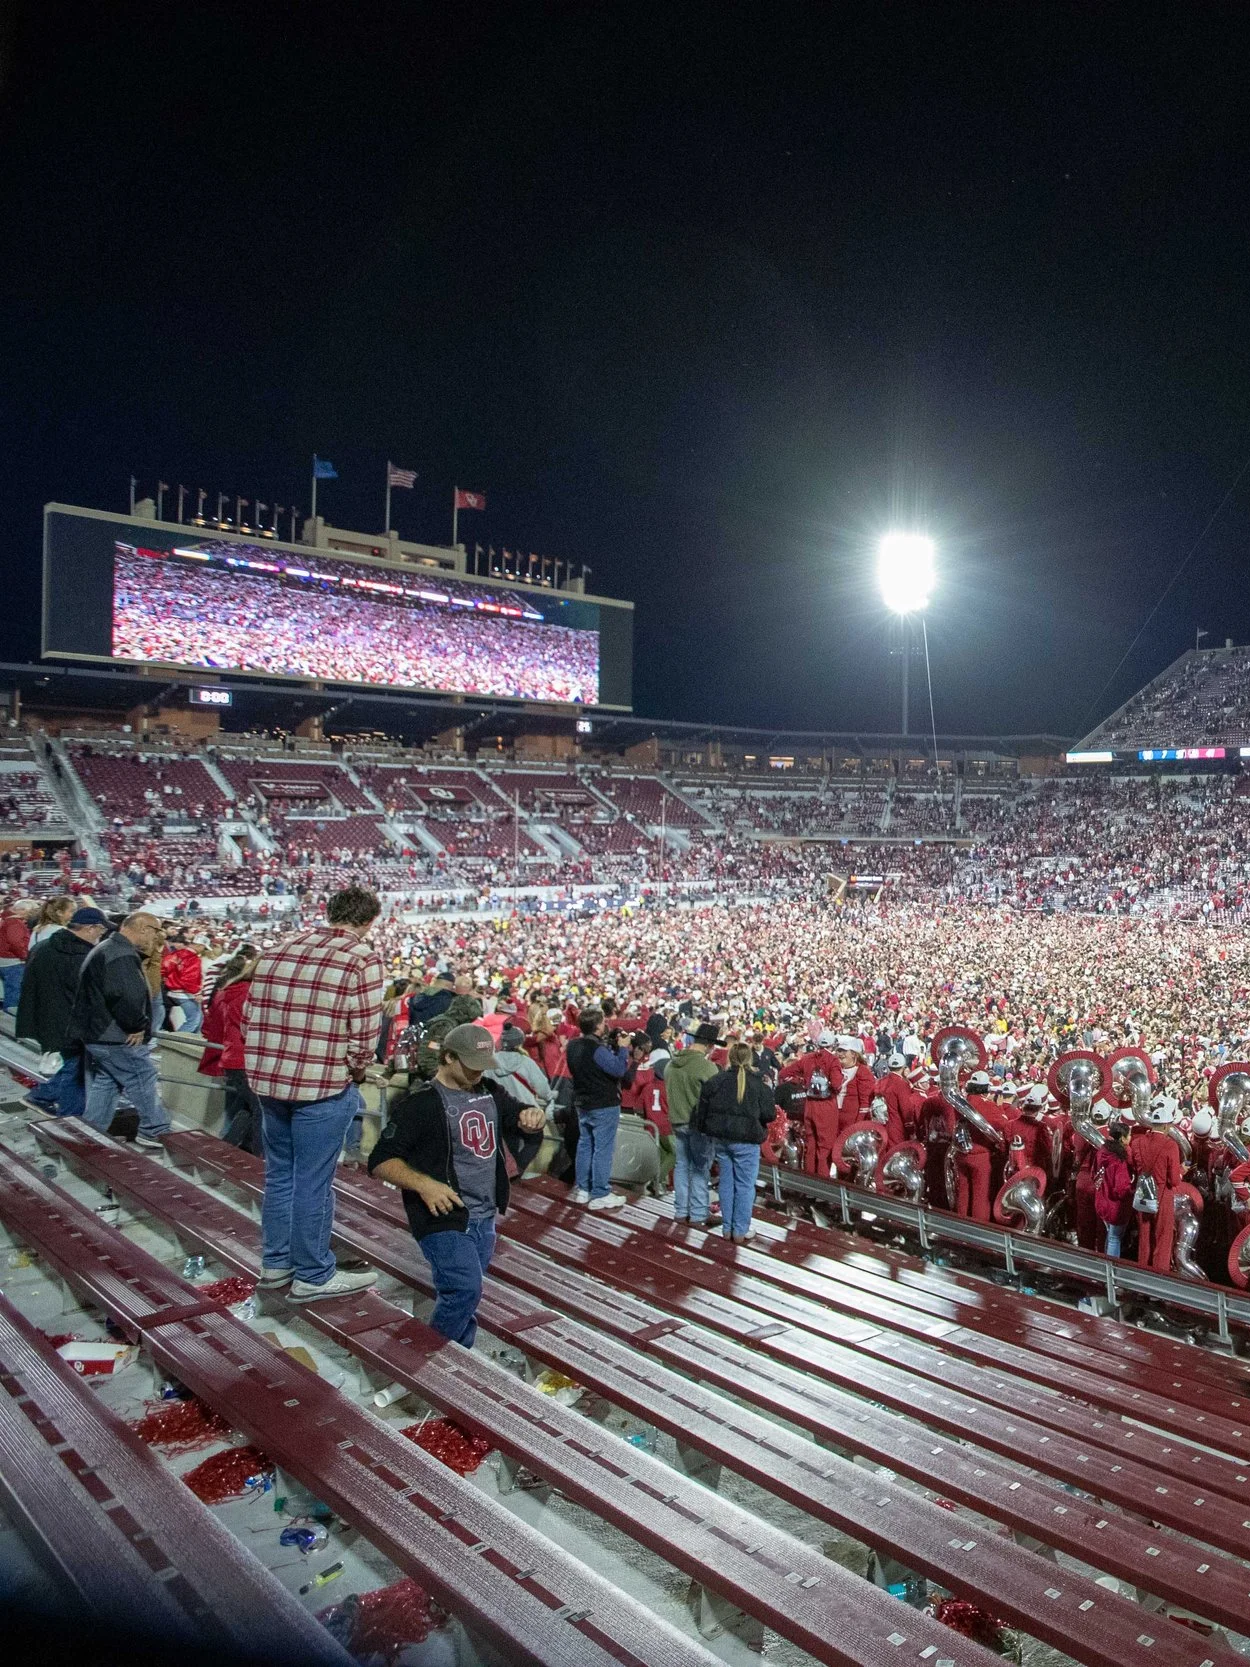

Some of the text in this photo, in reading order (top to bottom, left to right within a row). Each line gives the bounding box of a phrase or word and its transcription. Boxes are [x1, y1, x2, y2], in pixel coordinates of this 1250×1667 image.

[200, 690, 230, 704] 0:00
[652, 1088, 662, 1112] 1
[459, 1109, 497, 1159] OU
